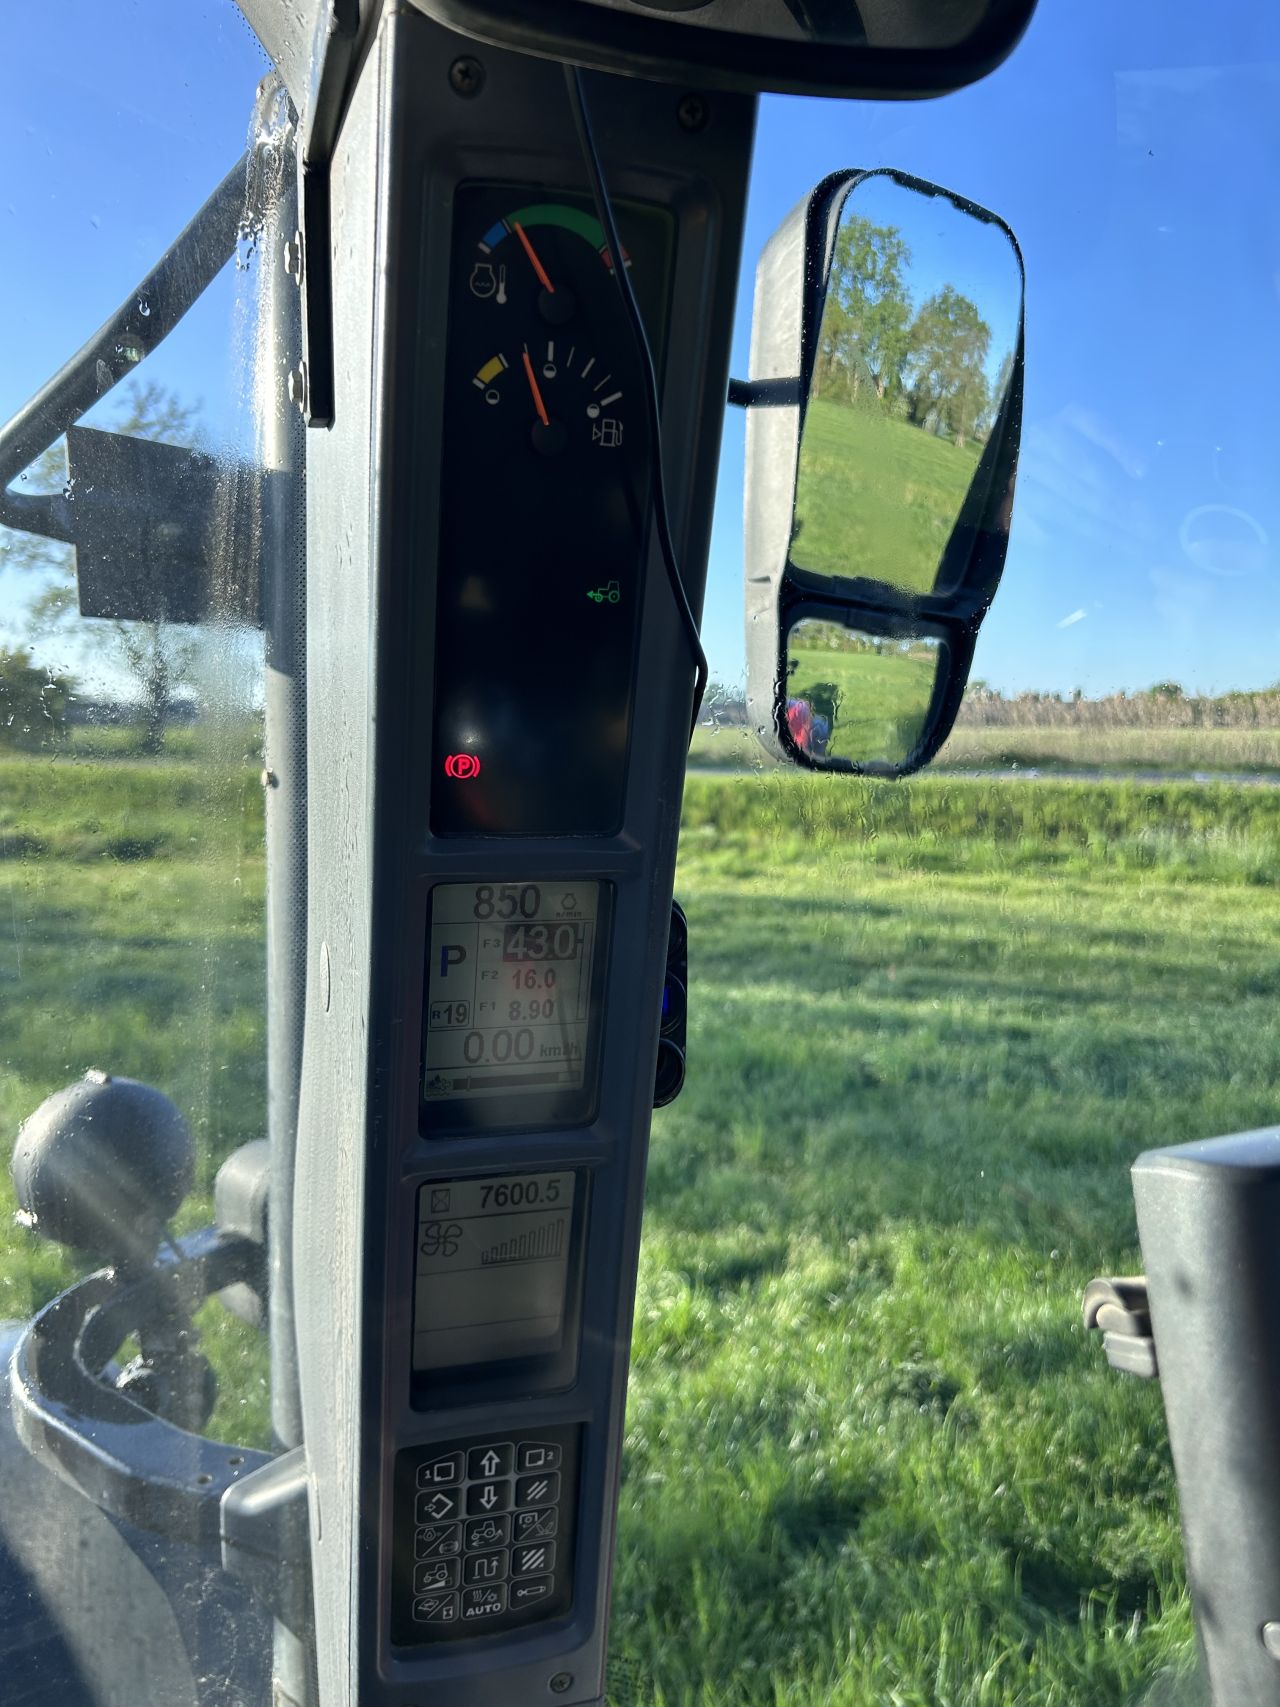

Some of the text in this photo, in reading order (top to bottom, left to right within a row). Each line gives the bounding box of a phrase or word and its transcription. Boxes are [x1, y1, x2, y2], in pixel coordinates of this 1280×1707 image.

[474, 884, 541, 920] 850
[483, 939, 501, 949] F3
[440, 945, 467, 977] P
[481, 967, 556, 990] F2 16.0
[443, 1003, 468, 1025] 19
[508, 999, 555, 1021] 8.90
[464, 1028, 535, 1064] 0.00
[480, 1179, 560, 1209] 7600.5
[546, 1451, 554, 1461] 2
[466, 1603, 501, 1616] AUTO
